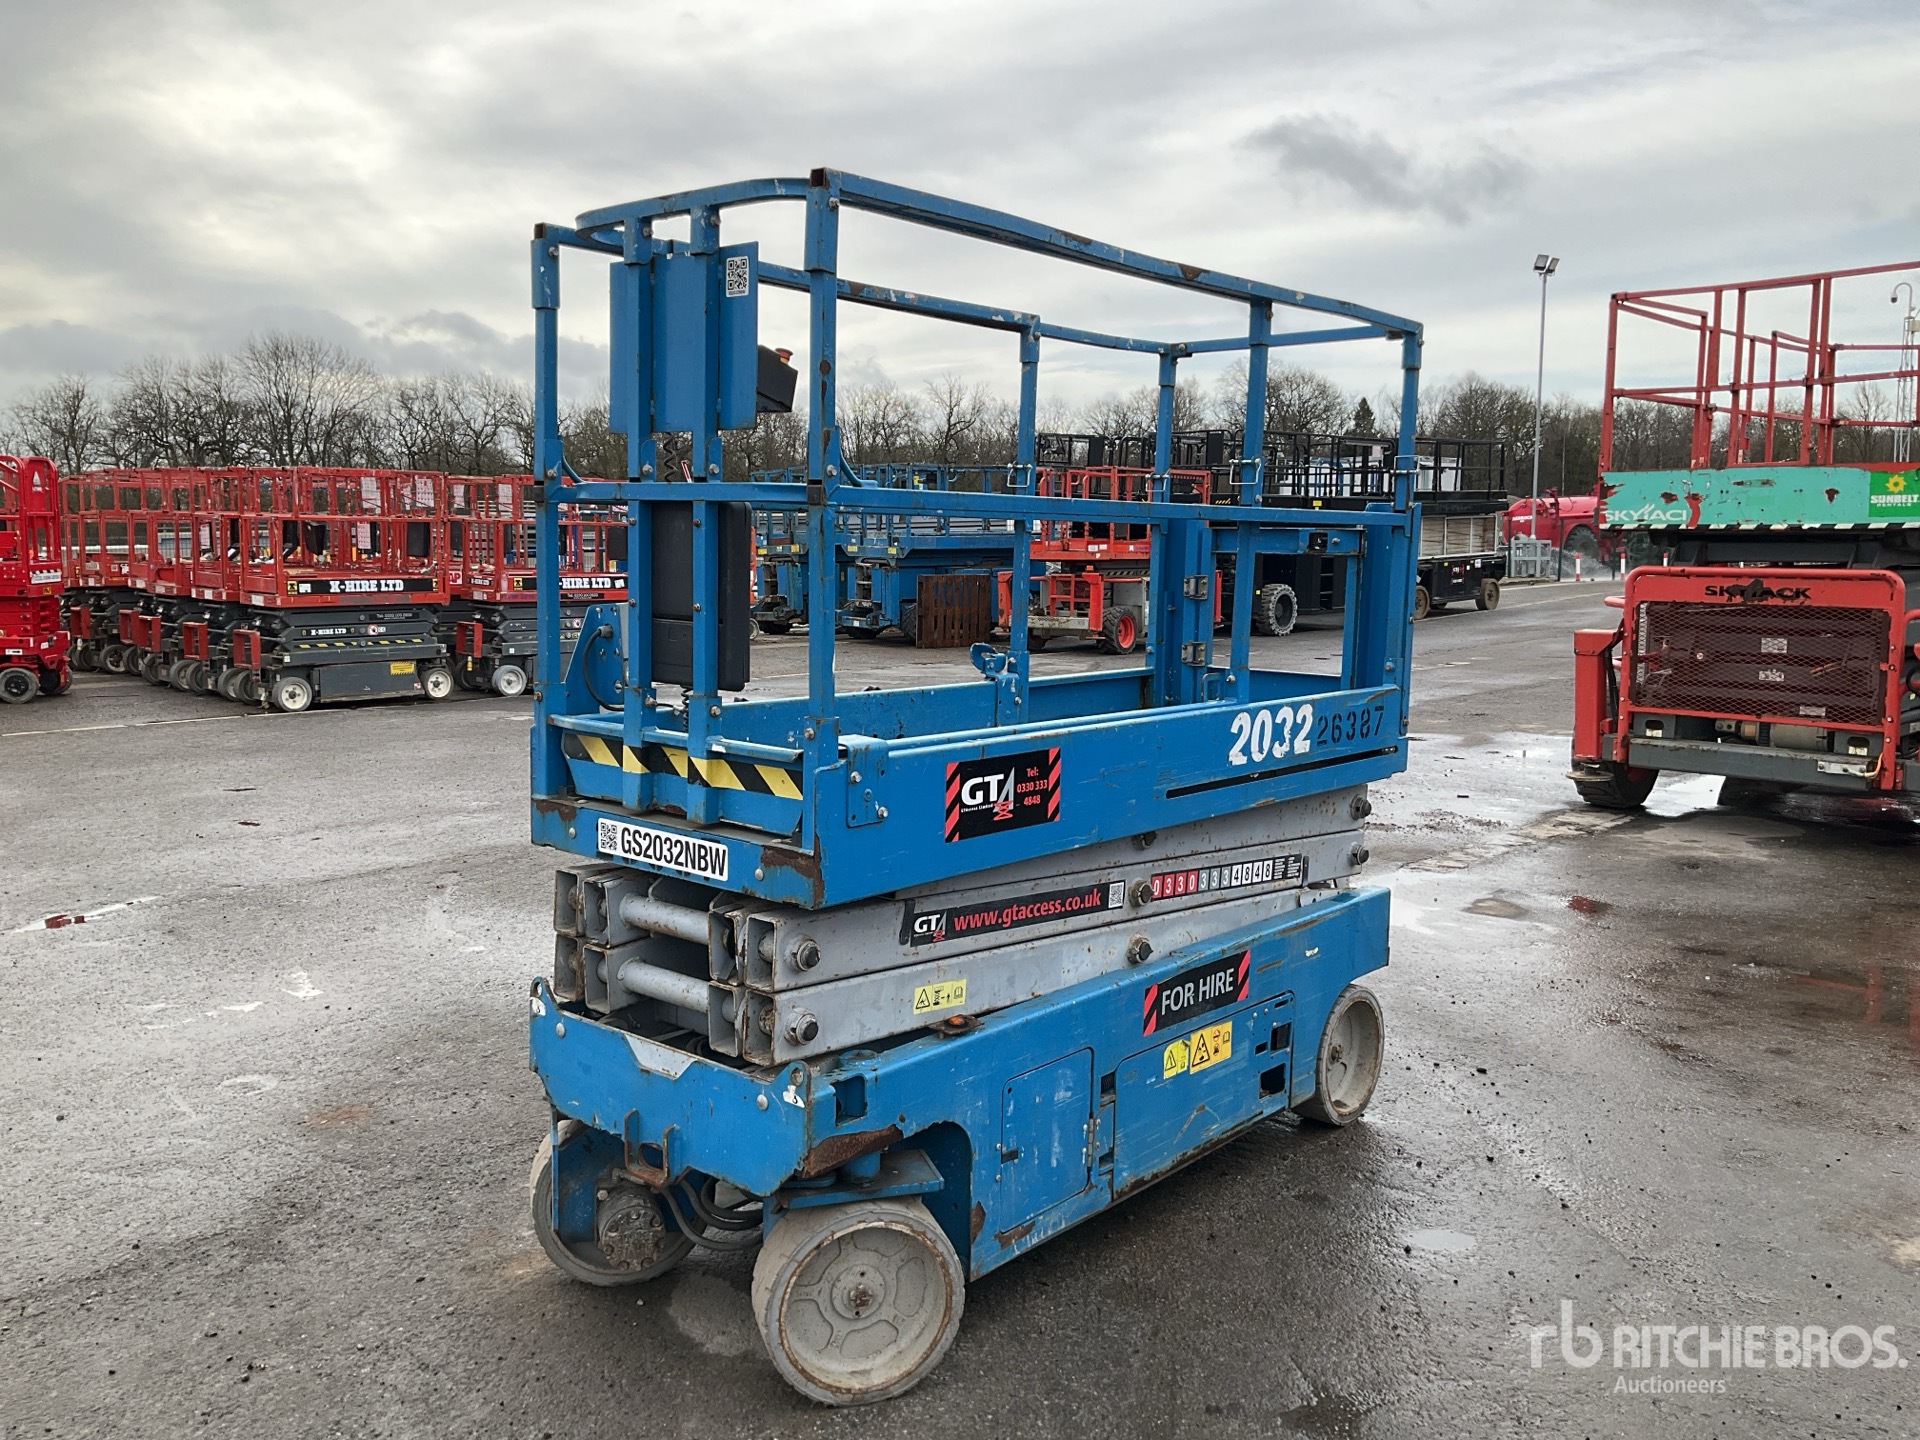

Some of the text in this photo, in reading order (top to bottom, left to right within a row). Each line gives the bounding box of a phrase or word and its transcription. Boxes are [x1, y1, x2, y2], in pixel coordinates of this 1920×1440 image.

[1870, 494, 1919, 504] SUNBELT
[380, 579, 404, 591] LTD
[558, 577, 611, 589] -HIRE LTD
[334, 627, 347, 635] LTD
[1228, 703, 1385, 766] 2032 26387
[1026, 766, 1039, 778] Tel:
[1016, 779, 1048, 794] 0330 333
[1023, 794, 1041, 806] 4848
[621, 826, 727, 877] GS2032NBW
[953, 888, 1101, 931] www.gtaccess.co.uk
[1161, 967, 1235, 1016] FOR HIRE
